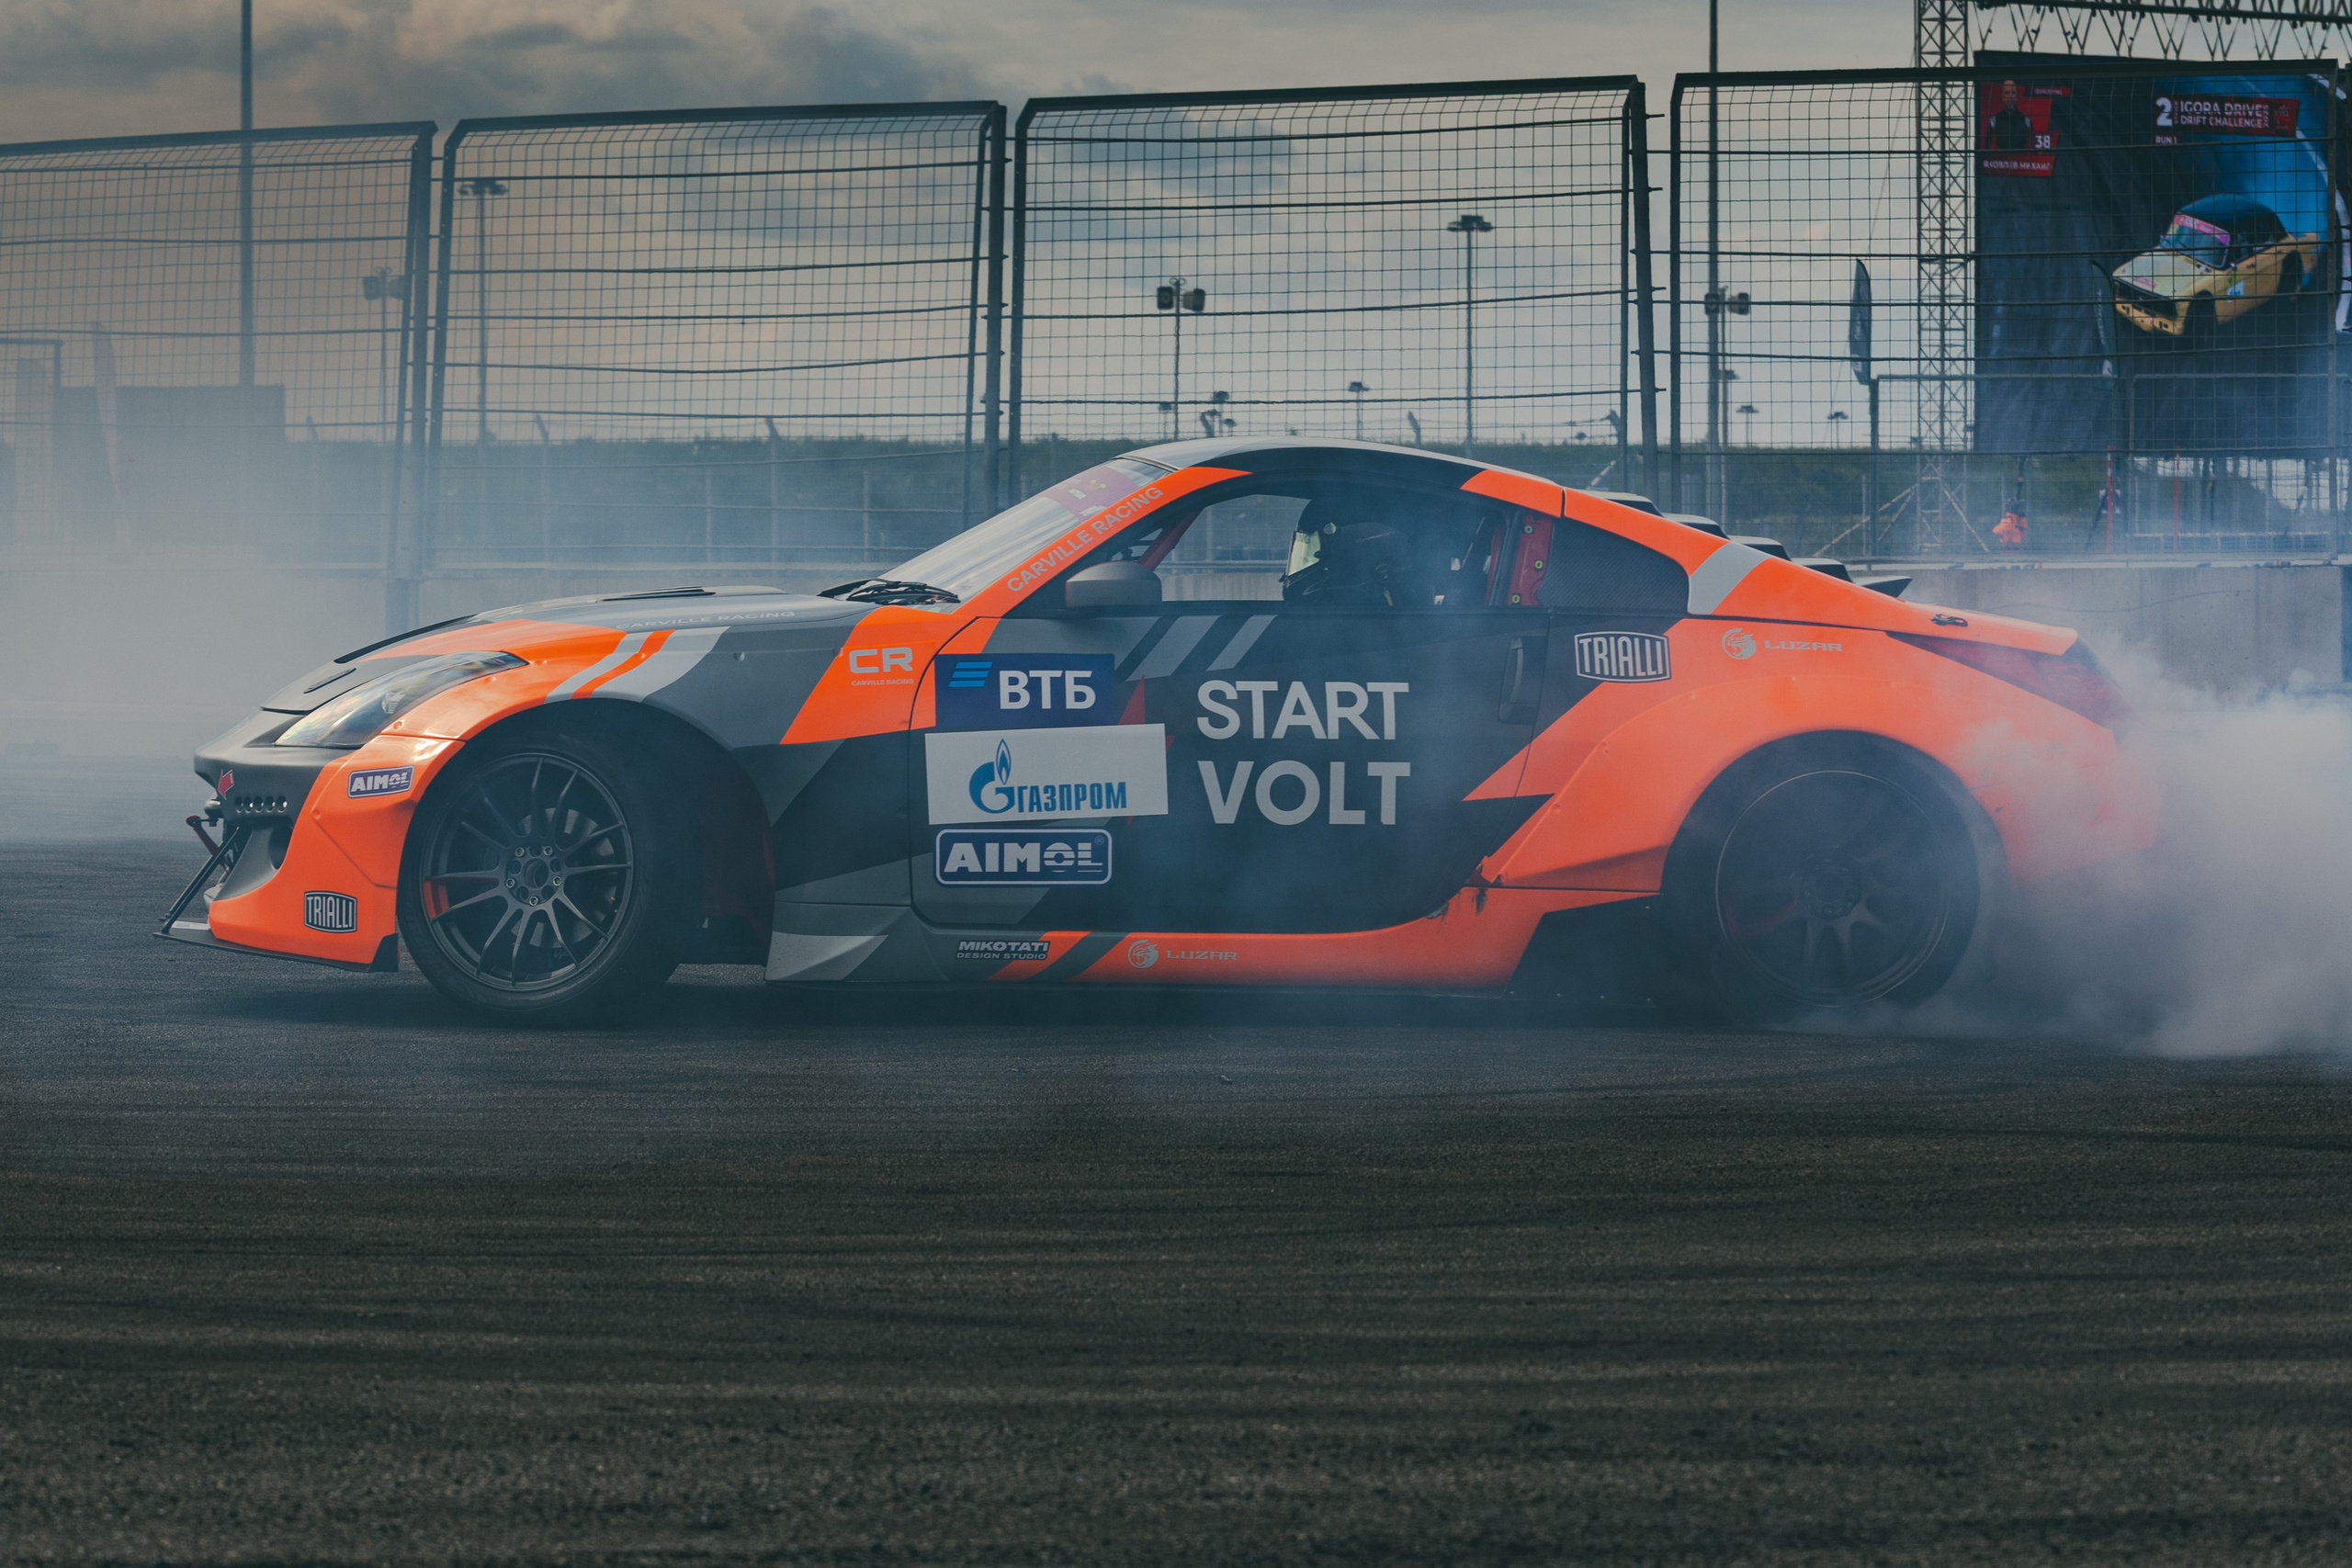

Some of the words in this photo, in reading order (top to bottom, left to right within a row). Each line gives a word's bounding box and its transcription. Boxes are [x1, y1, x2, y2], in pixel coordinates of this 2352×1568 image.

[2155, 97, 2173, 126] 2
[2180, 101, 2221, 116] IGORA
[2224, 103, 2262, 118] DRIVE
[2180, 115, 2206, 126] DRIFT
[2209, 117, 2263, 129] CHALLENGE
[2035, 135, 2051, 148] 38
[2155, 136, 2173, 144] RUN
[1008, 530, 1093, 592] CARVILLE
[1091, 487, 1164, 535] RACING
[616, 616, 712, 629] CARVILLE
[718, 611, 796, 622] RACING
[1578, 635, 1665, 677] TRIALLI
[1764, 639, 1844, 652] LUZAR
[849, 647, 913, 674] CR
[999, 670, 1096, 710] ВТБ
[1197, 680, 1409, 740] START
[351, 772, 410, 793] AIMOL
[1197, 760, 1411, 826] VOLT
[1017, 782, 1127, 814] ГАЗПРОМ
[944, 841, 1103, 873] AIMOL
[307, 896, 353, 929] TRIALLI
[958, 942, 1049, 952] MIKOTATI
[1166, 950, 1238, 961] LUZAR
